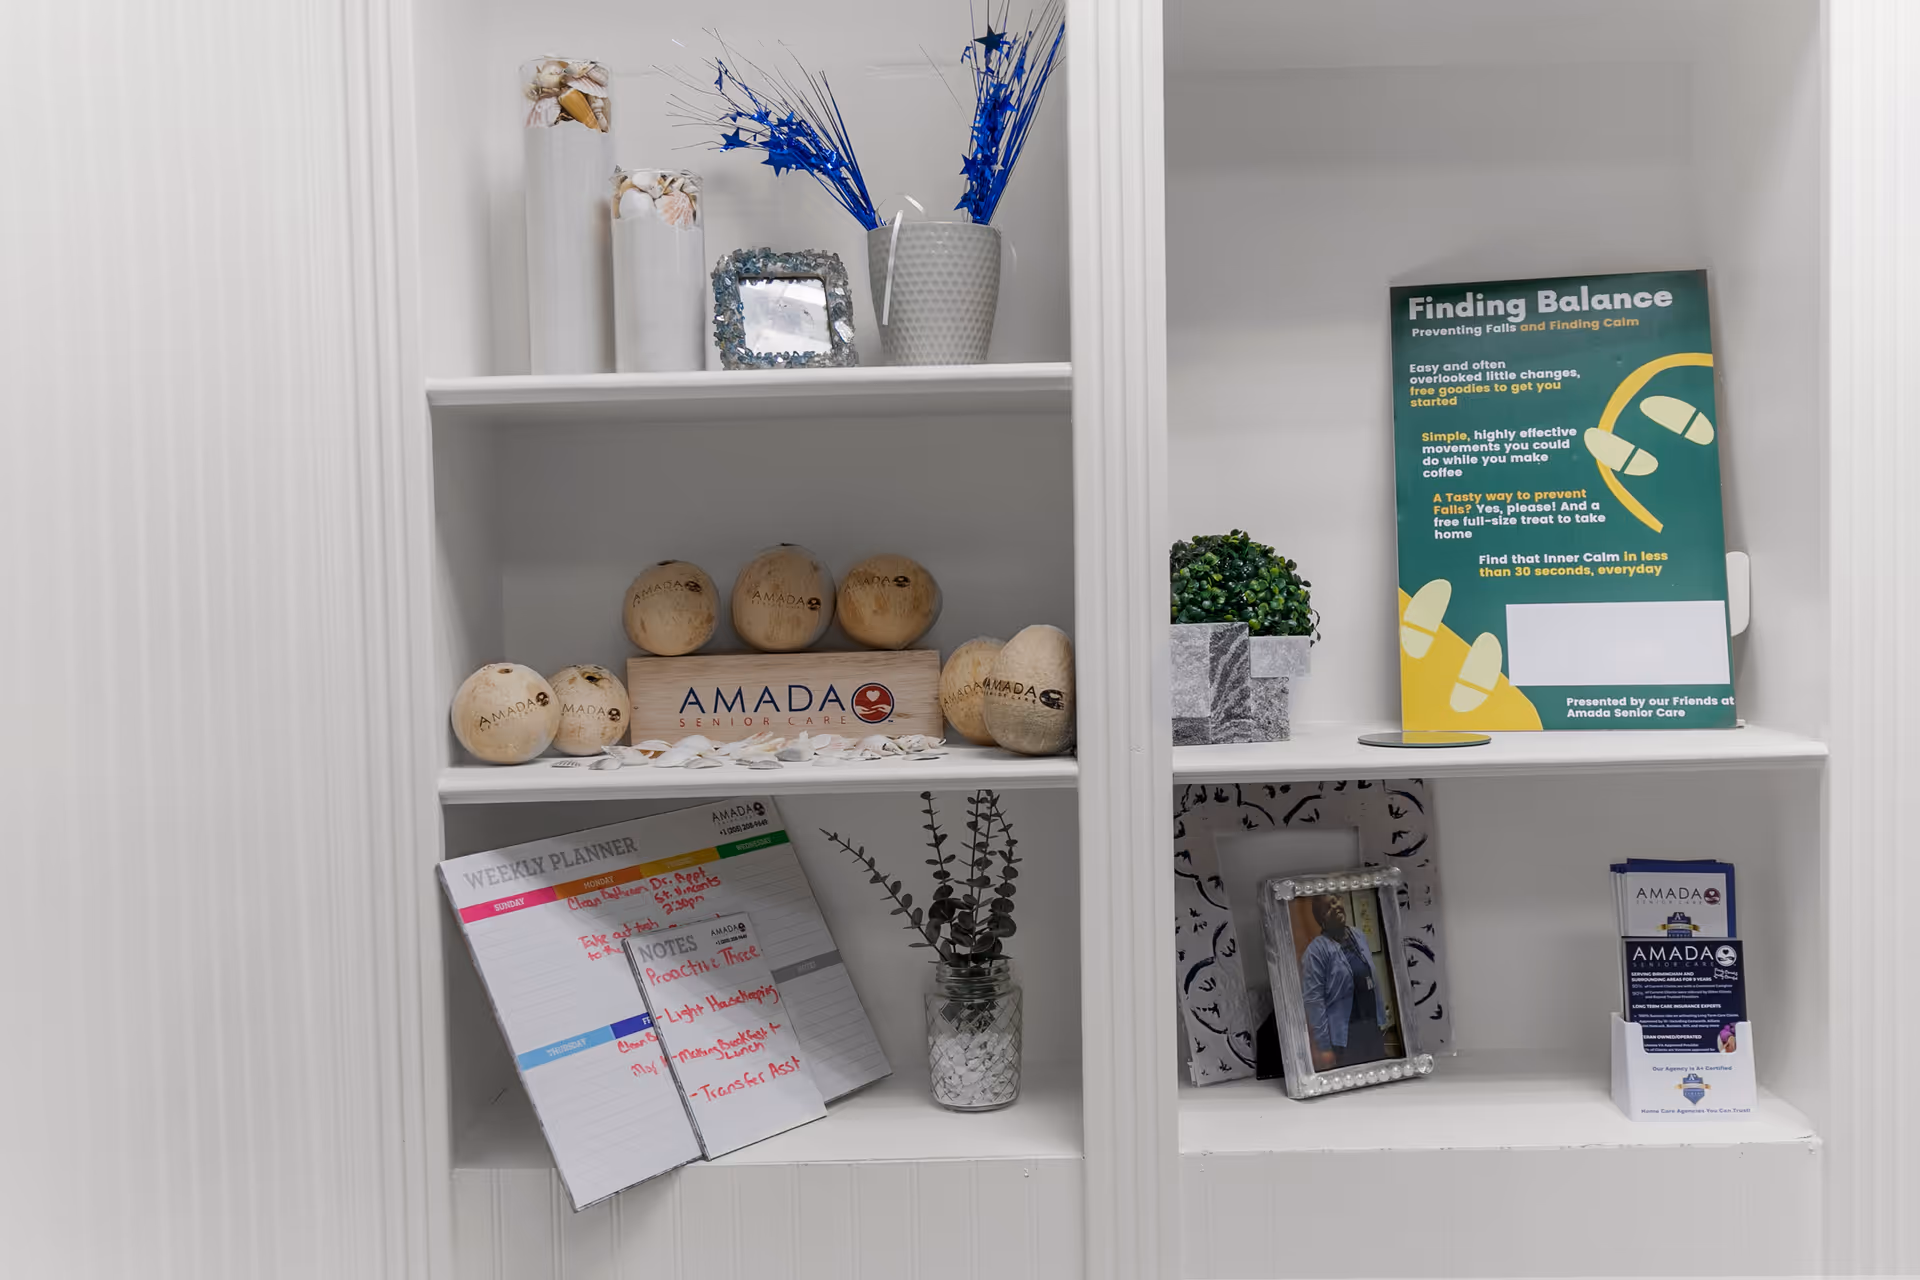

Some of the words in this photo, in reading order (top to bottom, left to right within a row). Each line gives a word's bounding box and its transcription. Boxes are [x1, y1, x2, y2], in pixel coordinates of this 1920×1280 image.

[1408, 292, 1526, 323] Finding
[1537, 286, 1673, 313] Balance
[1412, 323, 1482, 337] Preventing
[1486, 322, 1517, 333] Falls
[1520, 320, 1546, 332] and
[1550, 319, 1600, 331] Finding
[1603, 317, 1639, 328] Calm
[1409, 363, 1439, 376] Easy
[1443, 360, 1468, 372] and
[1472, 359, 1506, 370] often
[1409, 371, 1483, 384] overlooked
[1486, 370, 1516, 381] little
[1520, 367, 1581, 382] changes,
[1409, 385, 1435, 396] free
[1438, 383, 1490, 397] goodies
[1494, 382, 1508, 392] to
[1511, 381, 1533, 394] get
[1537, 380, 1561, 392] you
[1410, 396, 1457, 407] started
[1422, 430, 1471, 445] Simple,
[1474, 428, 1516, 443] highly
[1519, 427, 1577, 439] effective
[1422, 442, 1500, 454] movements
[1504, 441, 1529, 453] you
[1532, 439, 1570, 450] could
[1422, 454, 1439, 466] do
[1442, 453, 1478, 465] while
[1482, 454, 1507, 466] you
[1510, 451, 1548, 463] make
[1423, 467, 1462, 478] coffee
[1433, 493, 1442, 503] A
[1445, 492, 1482, 505] Tasty
[1486, 492, 1513, 504] way
[1517, 490, 1531, 500] to
[1534, 489, 1586, 502] prevent
[1433, 504, 1472, 515] Falls?
[1476, 503, 1503, 516] Yes,
[1507, 501, 1556, 515] please!
[1560, 500, 1587, 512] And
[1591, 502, 1600, 511] a
[1434, 516, 1459, 527] free
[1463, 515, 1517, 527] full-size
[1521, 514, 1553, 525] treat
[1557, 514, 1571, 524] to
[1575, 512, 1606, 524] take
[1434, 528, 1472, 540] home
[1479, 554, 1507, 565] Find
[1511, 553, 1540, 564] that
[1543, 552, 1579, 564] Inner
[1583, 551, 1620, 563] Calm
[1623, 551, 1637, 562] in
[1641, 550, 1668, 561] less
[1479, 566, 1511, 577] than
[1515, 566, 1531, 577] 30
[1534, 564, 1594, 578] seconds,
[1598, 564, 1662, 577] everyday
[633, 580, 683, 604] AMADA
[752, 590, 805, 606] AMADA
[944, 681, 982, 706] AMADA
[985, 677, 1037, 699] AMADA
[679, 683, 846, 714] AMADA
[1566, 697, 1627, 707] Presented
[1630, 696, 1646, 709] by
[1648, 697, 1669, 707] our
[1673, 695, 1718, 706] Friends
[1721, 696, 1735, 706] at
[479, 698, 536, 728] AMADA
[562, 703, 606, 717] MADA
[1567, 708, 1611, 718] Amada
[1614, 707, 1653, 718] Senior
[1656, 707, 1686, 718] Care
[679, 717, 770, 727] SENIOR
[788, 715, 847, 726] CARE
[712, 804, 754, 823] AMADA
[463, 856, 546, 890] WEEKLY
[548, 837, 638, 871] PLANNER
[583, 876, 614, 890] MONDAY
[1636, 887, 1702, 899] AMADA
[494, 898, 525, 912] SUNDAY
[711, 924, 739, 936] AMADA
[638, 935, 698, 963] NOTES
[1633, 945, 1714, 961] AMADA
[546, 1038, 587, 1057] THURSDAY
